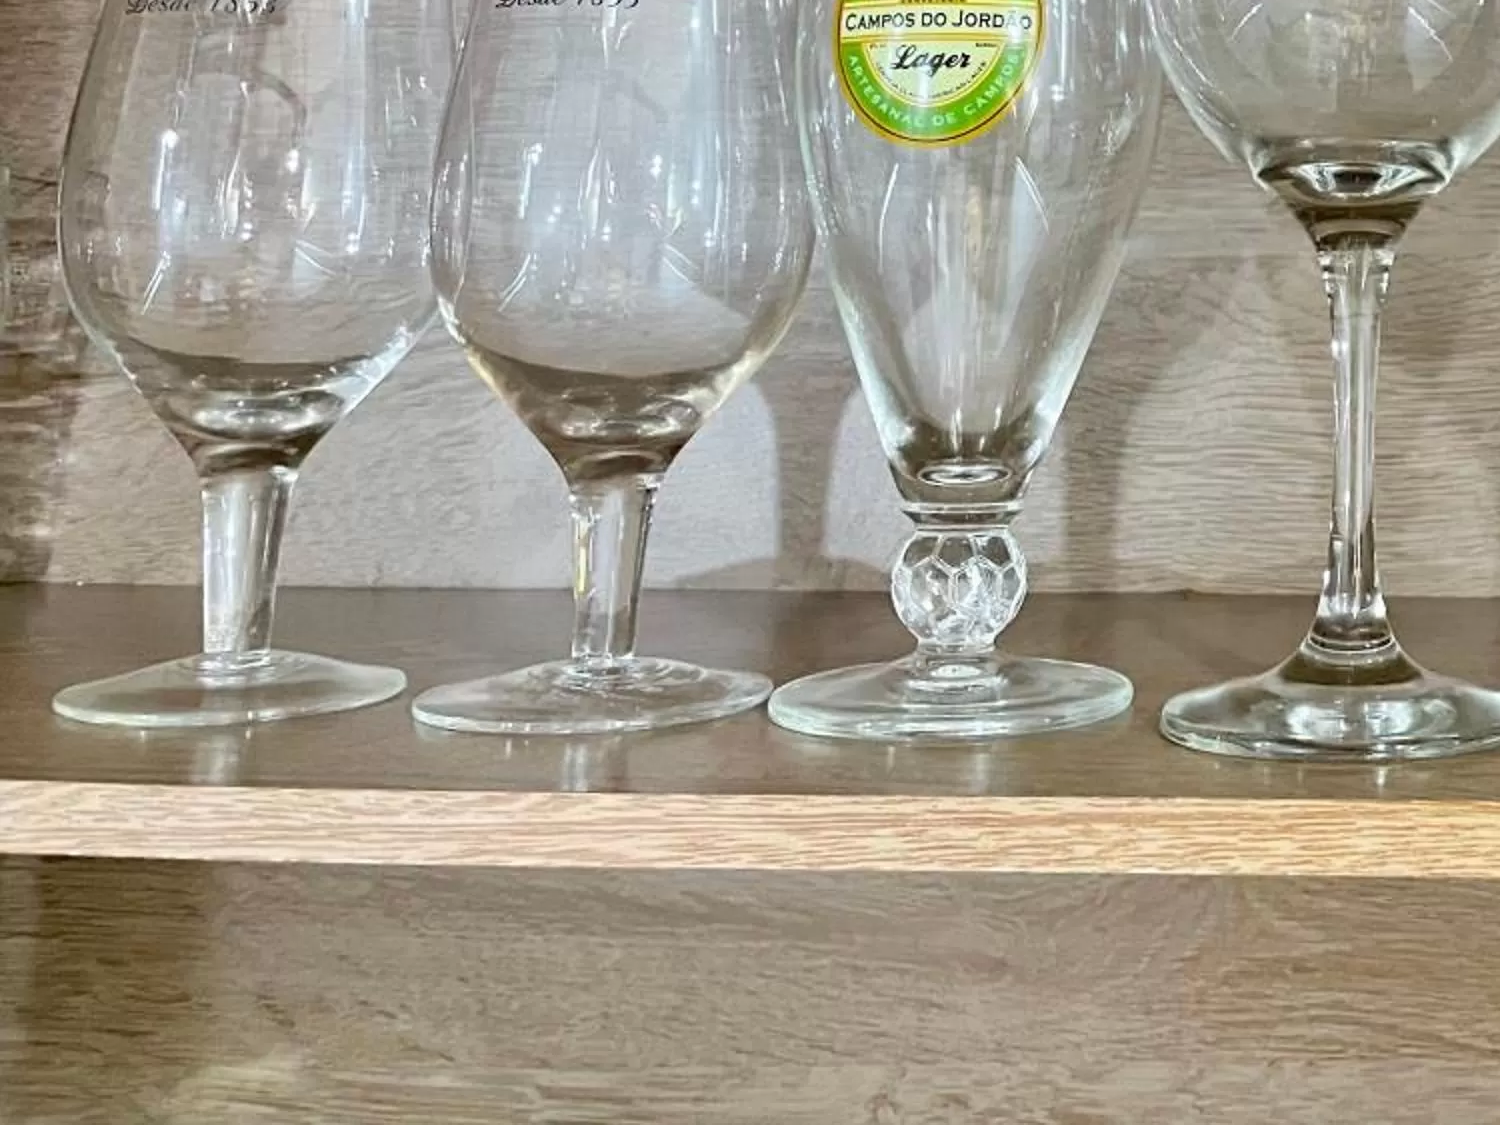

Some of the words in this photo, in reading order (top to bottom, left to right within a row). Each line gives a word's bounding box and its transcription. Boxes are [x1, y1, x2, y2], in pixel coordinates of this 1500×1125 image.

[845, 12, 915, 31] CAMPOS
[921, 12, 947, 28] DO
[890, 44, 971, 78] Lager
[848, 55, 925, 128] ARTESANAL
[932, 111, 957, 127] DE
